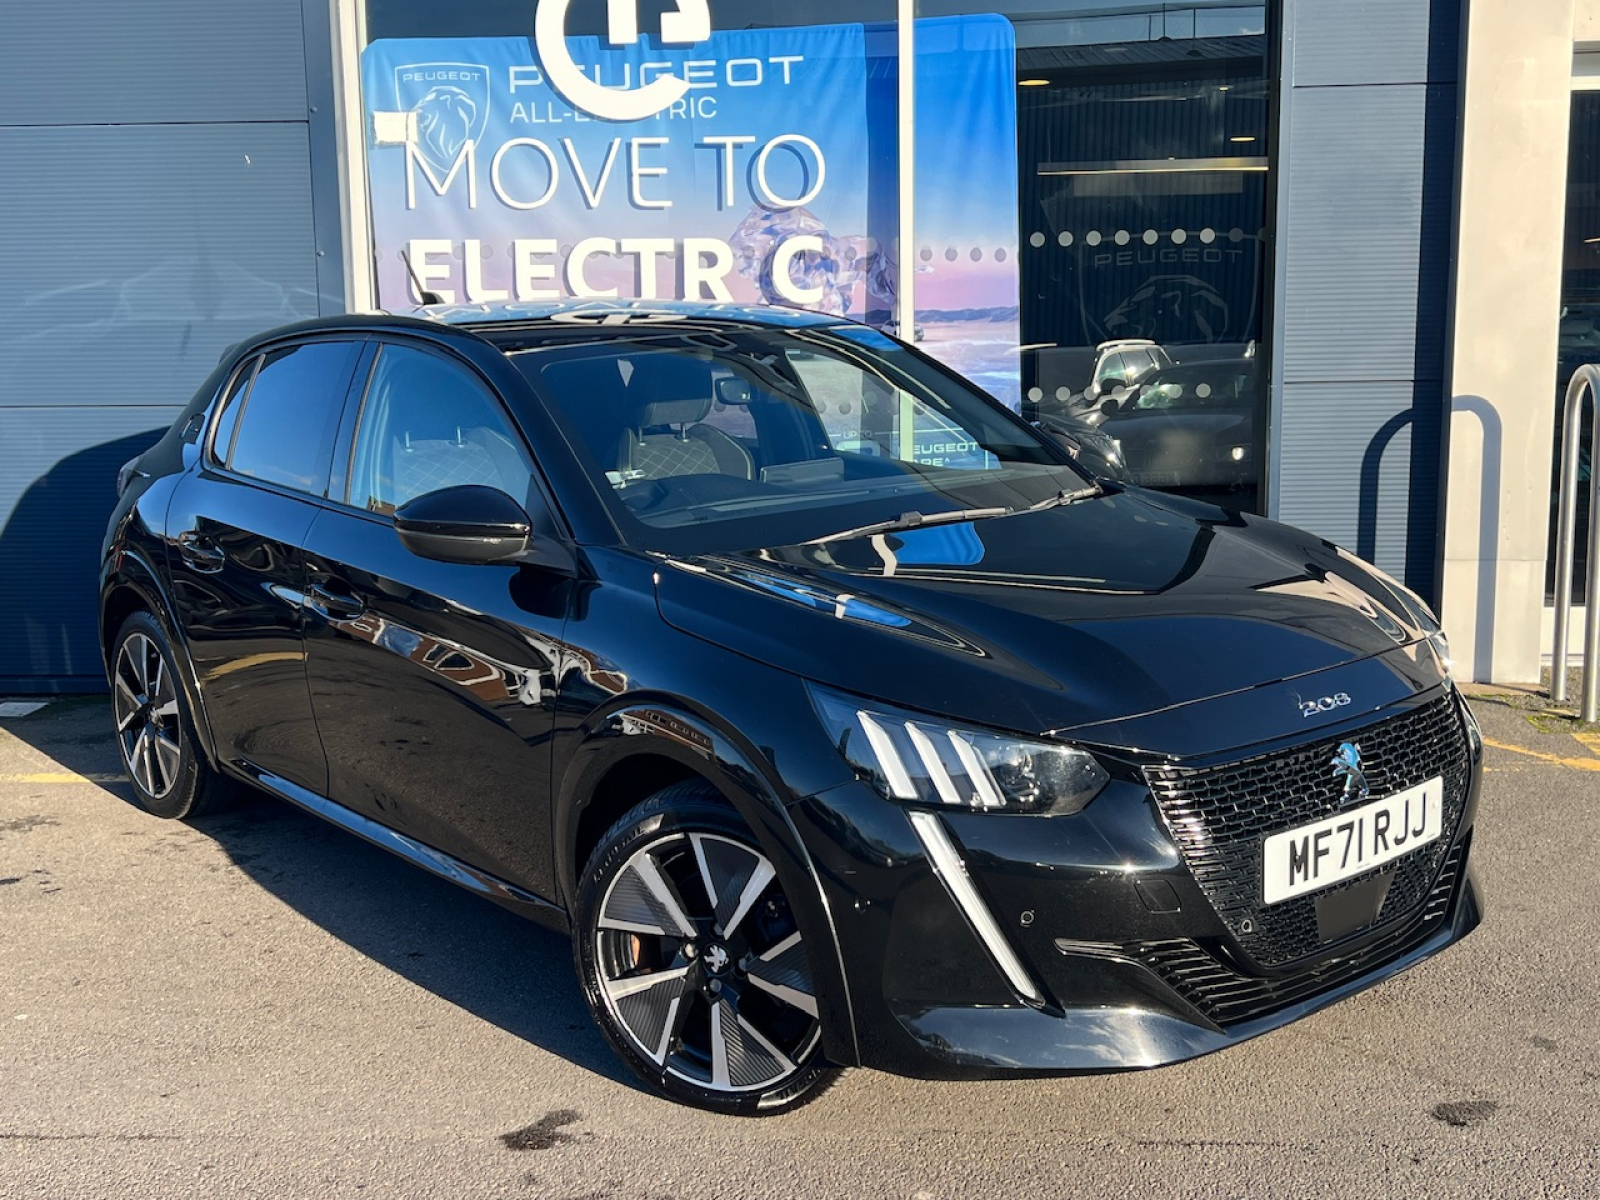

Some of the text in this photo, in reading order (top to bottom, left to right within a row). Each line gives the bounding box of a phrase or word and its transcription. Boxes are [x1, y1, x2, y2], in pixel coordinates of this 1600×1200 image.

[402, 70, 481, 84] PEUGEOT
[509, 55, 804, 94] PUGEOT
[404, 134, 826, 210] MOVE TO
[1094, 248, 1243, 269] PEUGEOT
[843, 430, 857, 440] UP
[913, 441, 979, 455] EUGEOT
[1299, 692, 1352, 718] 208
[1289, 791, 1427, 887] MF71 RJJ
